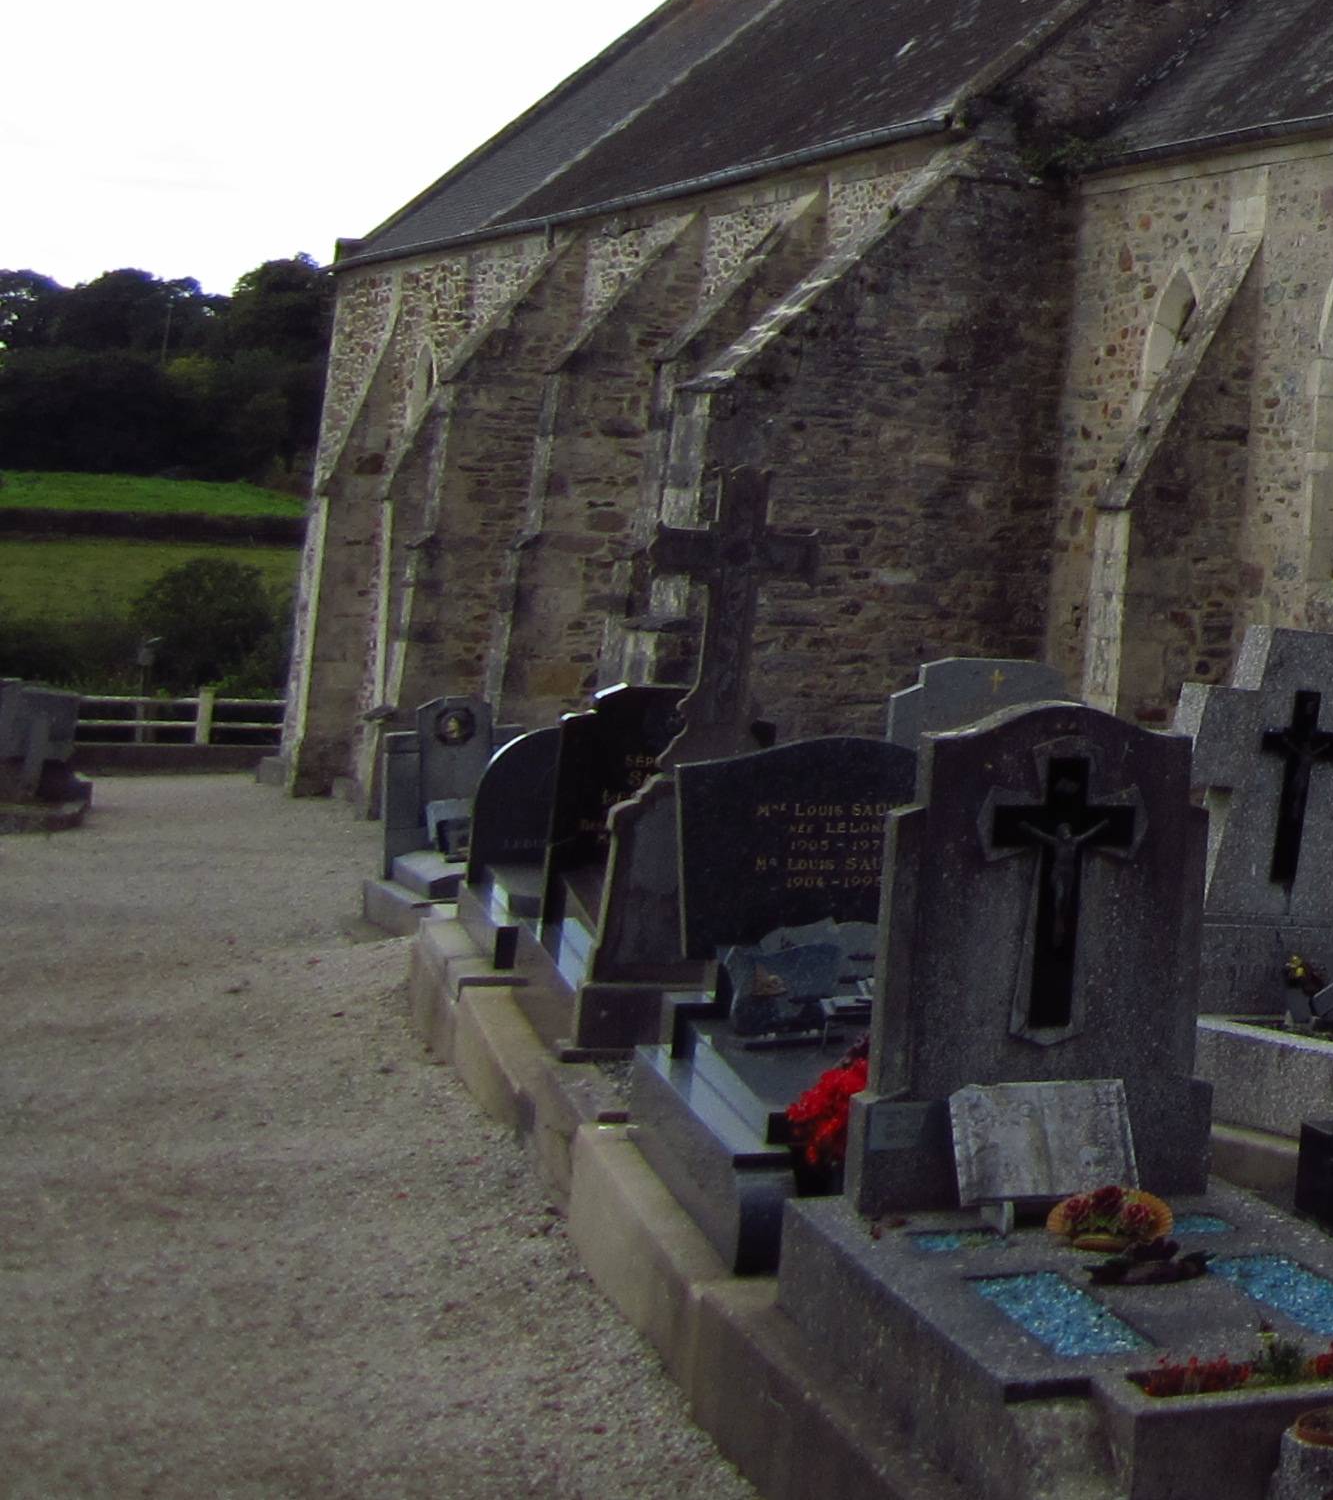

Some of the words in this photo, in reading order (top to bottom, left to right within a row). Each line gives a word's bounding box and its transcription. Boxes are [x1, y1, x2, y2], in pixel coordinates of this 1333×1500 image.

[851, 803, 888, 817] SAU
[825, 821, 883, 834] LELON
[791, 840, 831, 852] 1905
[853, 840, 881, 852] 197
